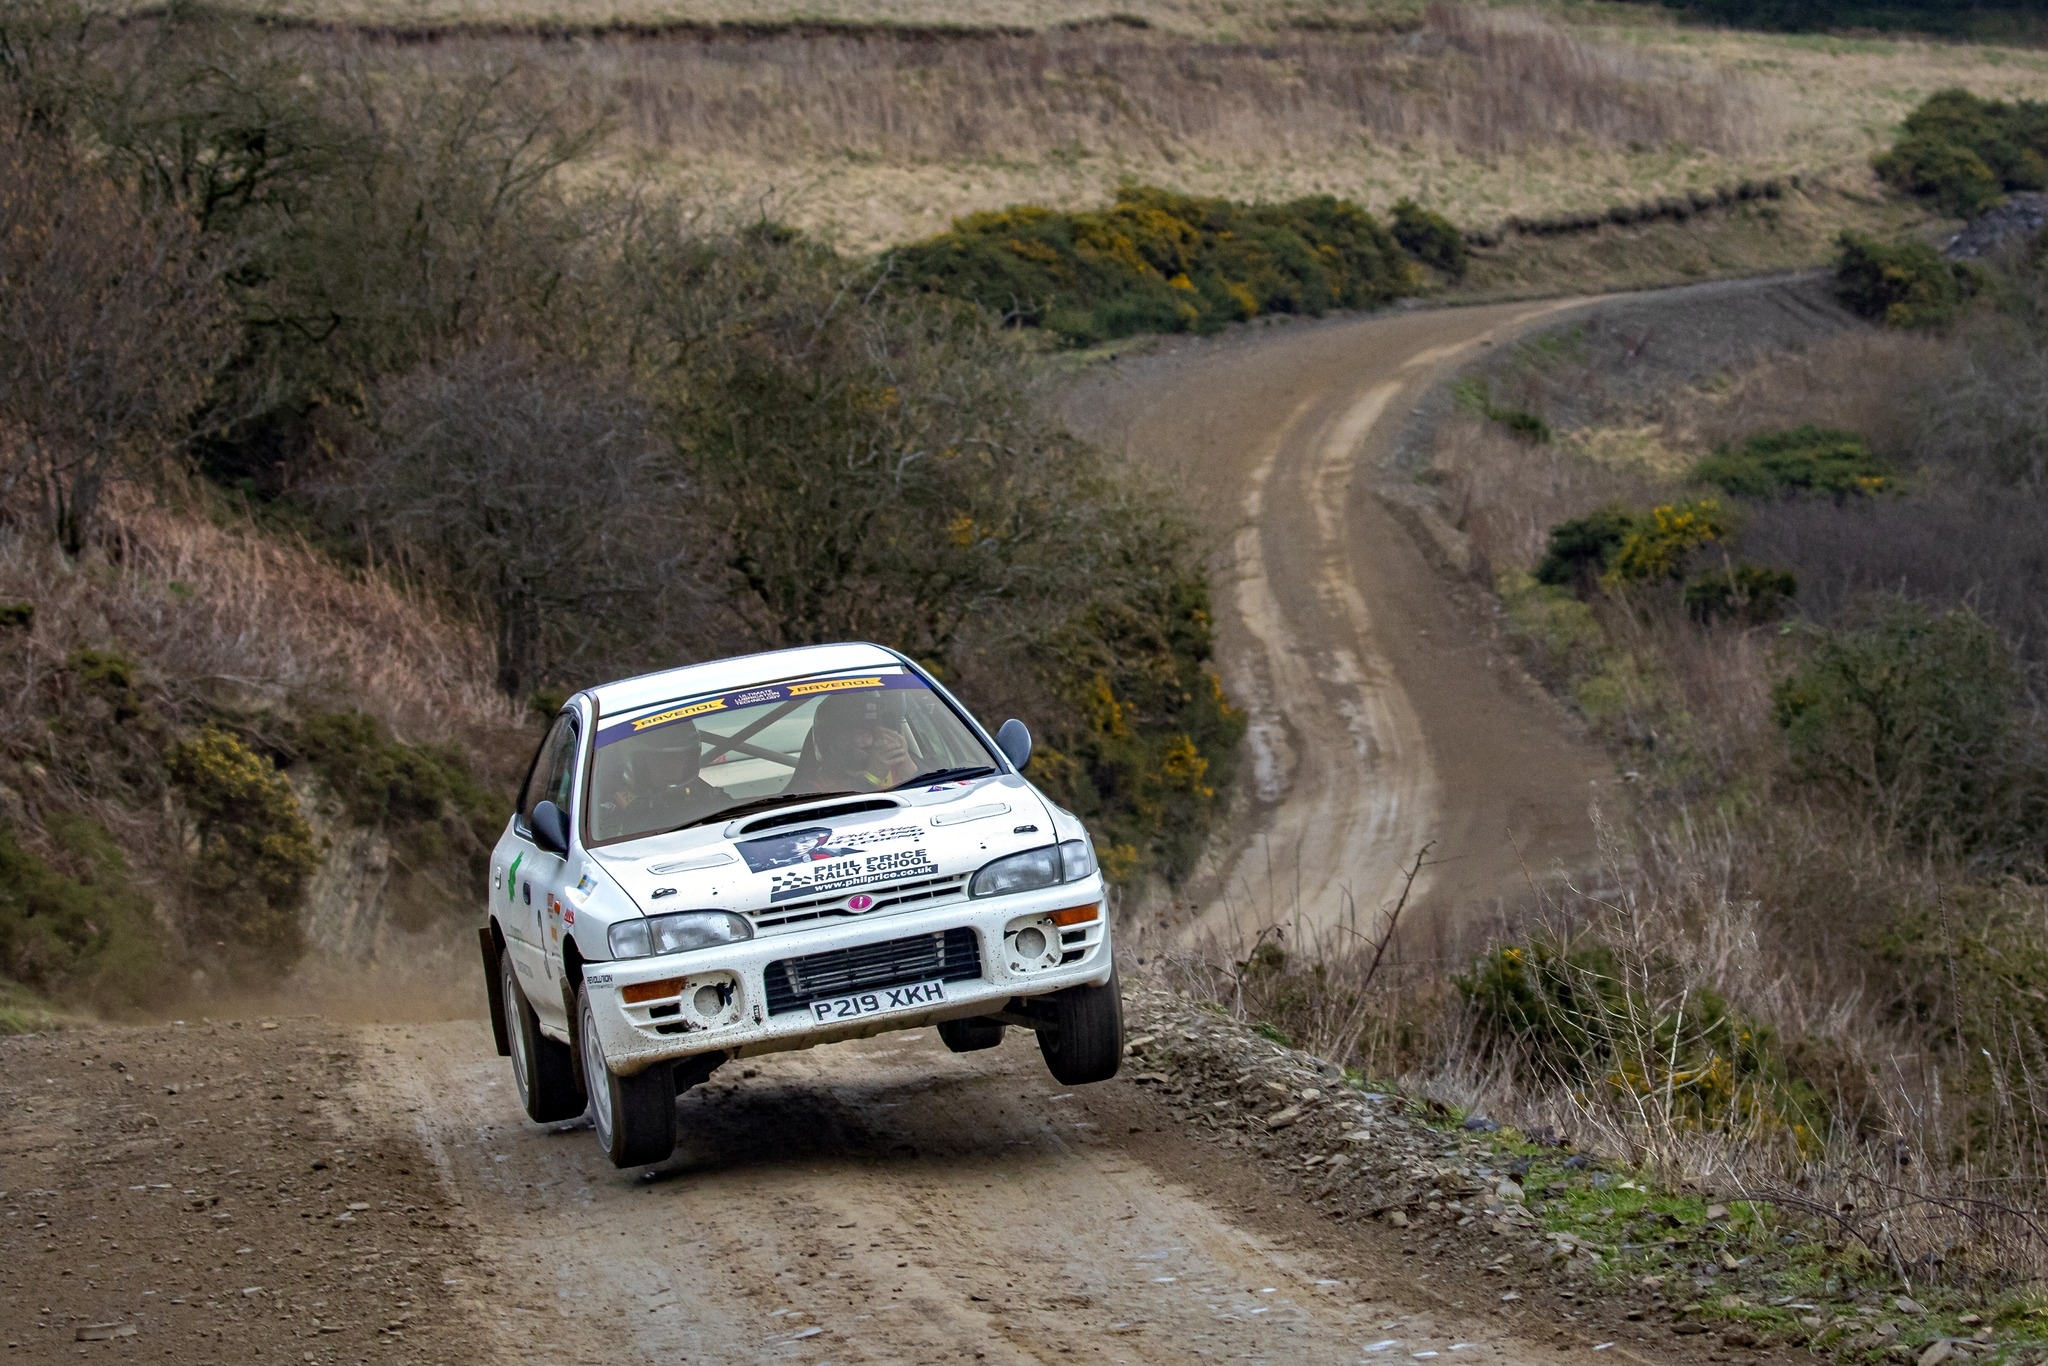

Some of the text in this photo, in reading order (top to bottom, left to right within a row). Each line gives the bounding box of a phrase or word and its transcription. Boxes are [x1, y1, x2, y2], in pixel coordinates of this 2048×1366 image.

[797, 680, 875, 692] RAVENOL
[641, 703, 718, 726] RAVENOL
[814, 849, 927, 875] PHIL PRICE
[814, 856, 931, 882] RALLY SCHOOL
[814, 865, 932, 892] www.philprice.co.uk
[814, 982, 944, 1021] P219 XKH
